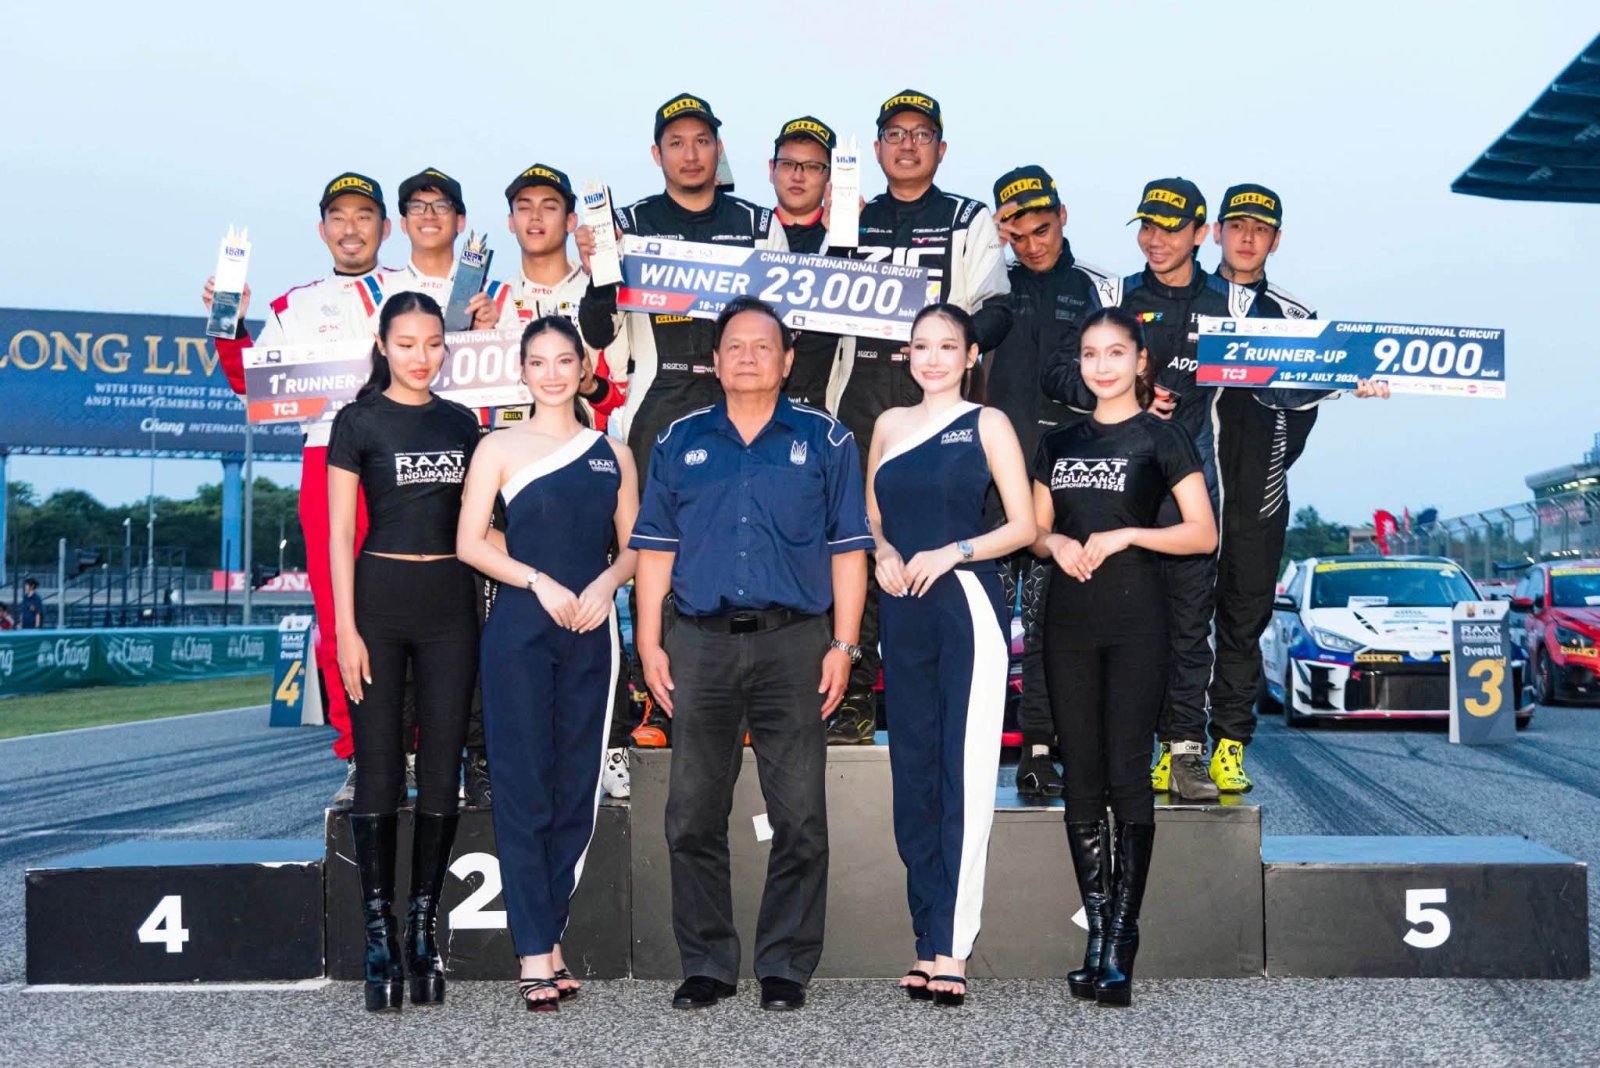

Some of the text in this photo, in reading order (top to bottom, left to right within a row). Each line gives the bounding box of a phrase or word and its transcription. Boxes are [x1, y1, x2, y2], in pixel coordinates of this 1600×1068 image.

[1001, 182, 1025, 200] Giti
[1232, 194, 1259, 204] Giti
[760, 252, 924, 279] CHANG INTERNATIONAL CIRCUIT
[640, 262, 751, 295] WINNER
[531, 287, 553, 295] arto
[758, 266, 904, 316] 23,000
[641, 292, 668, 307] TC3
[898, 307, 917, 317] baht
[1336, 323, 1501, 340] CHANG INTERNATIONAL CIRCUIT
[1244, 348, 1348, 364] RUNNER-UP
[1373, 338, 1484, 376] 9,000
[433, 343, 521, 389] ,000
[662, 362, 689, 371] sparco
[1222, 368, 1248, 380] TC3
[1480, 369, 1500, 378] baht
[1279, 372, 1308, 381] 18-19
[1308, 373, 1333, 382] JULY
[95, 382, 129, 394] WITH
[131, 384, 154, 395] THE
[157, 385, 205, 398] UTMOST
[84, 396, 112, 407] AND
[207, 400, 223, 412] OF
[272, 402, 298, 416] TC3
[140, 417, 185, 436] Chang
[395, 454, 465, 471] RAAT
[1054, 461, 1127, 473] RAAT
[396, 471, 465, 481] ENDURANCE
[1051, 475, 1126, 486] ENDURANCE
[1461, 625, 1501, 635] RAAT
[55, 638, 90, 671] Chang
[122, 637, 154, 669] Chang
[185, 636, 213, 665] Chang
[240, 634, 264, 661] Chang
[1462, 645, 1503, 656] Overall
[1185, 743, 1200, 751] OMP
[448, 852, 507, 930] 2
[137, 895, 190, 953] 4
[1402, 888, 1452, 949] 5
